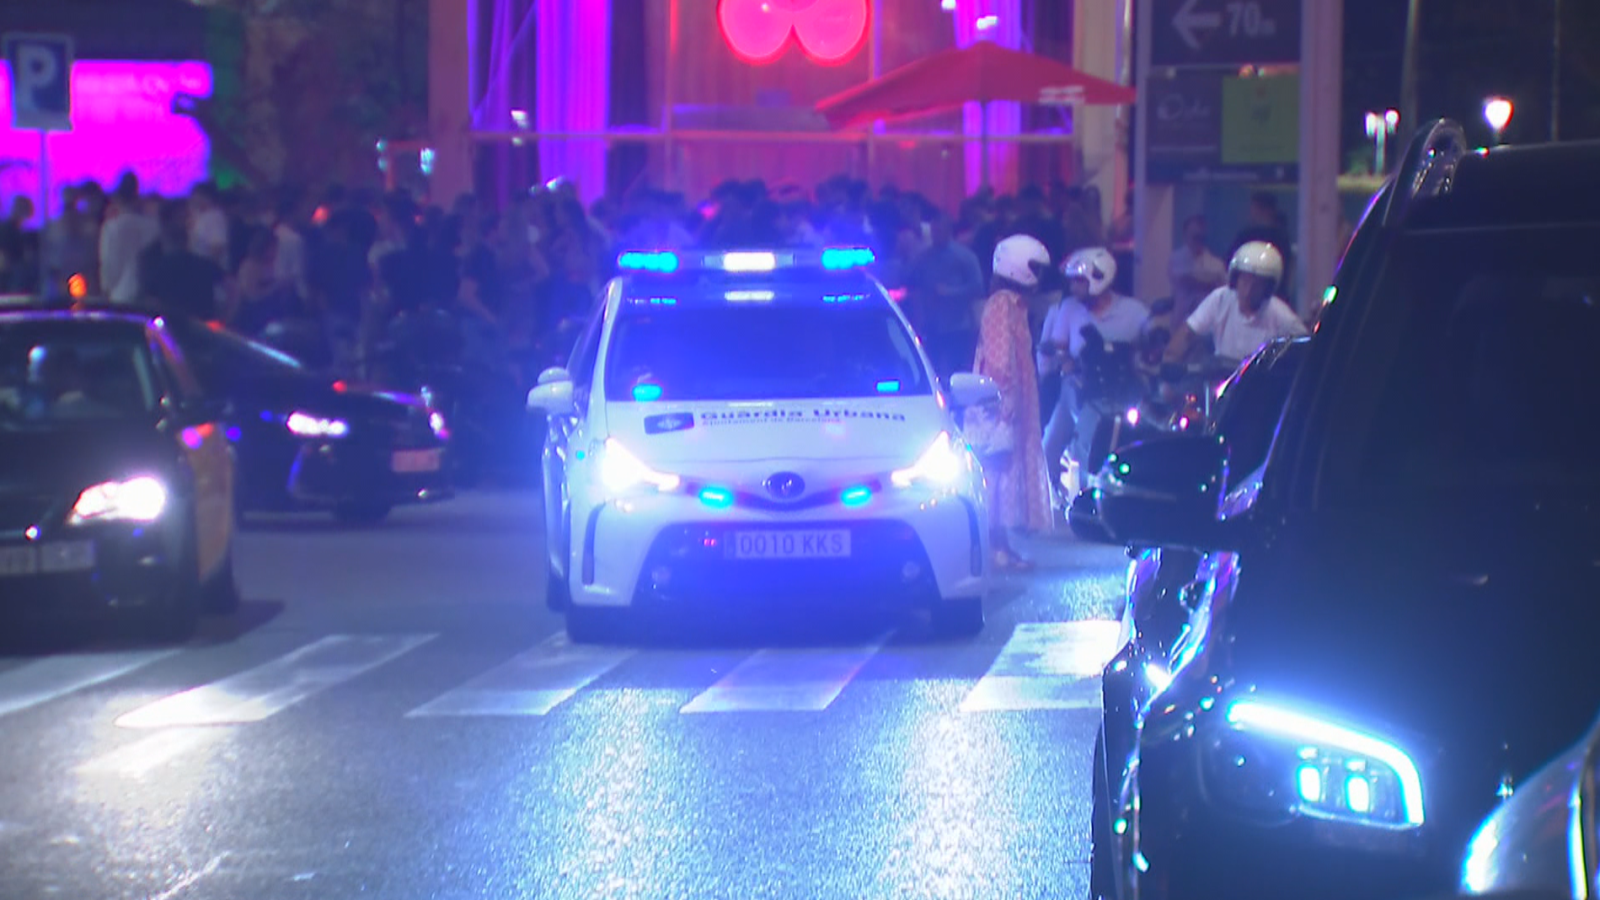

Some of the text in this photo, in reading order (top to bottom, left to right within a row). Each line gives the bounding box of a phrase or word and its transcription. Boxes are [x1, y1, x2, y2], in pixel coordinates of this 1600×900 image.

[17, 46, 57, 113] P
[813, 408, 906, 422] Urbana
[740, 534, 794, 555] 0010
[803, 533, 843, 553] KKS
